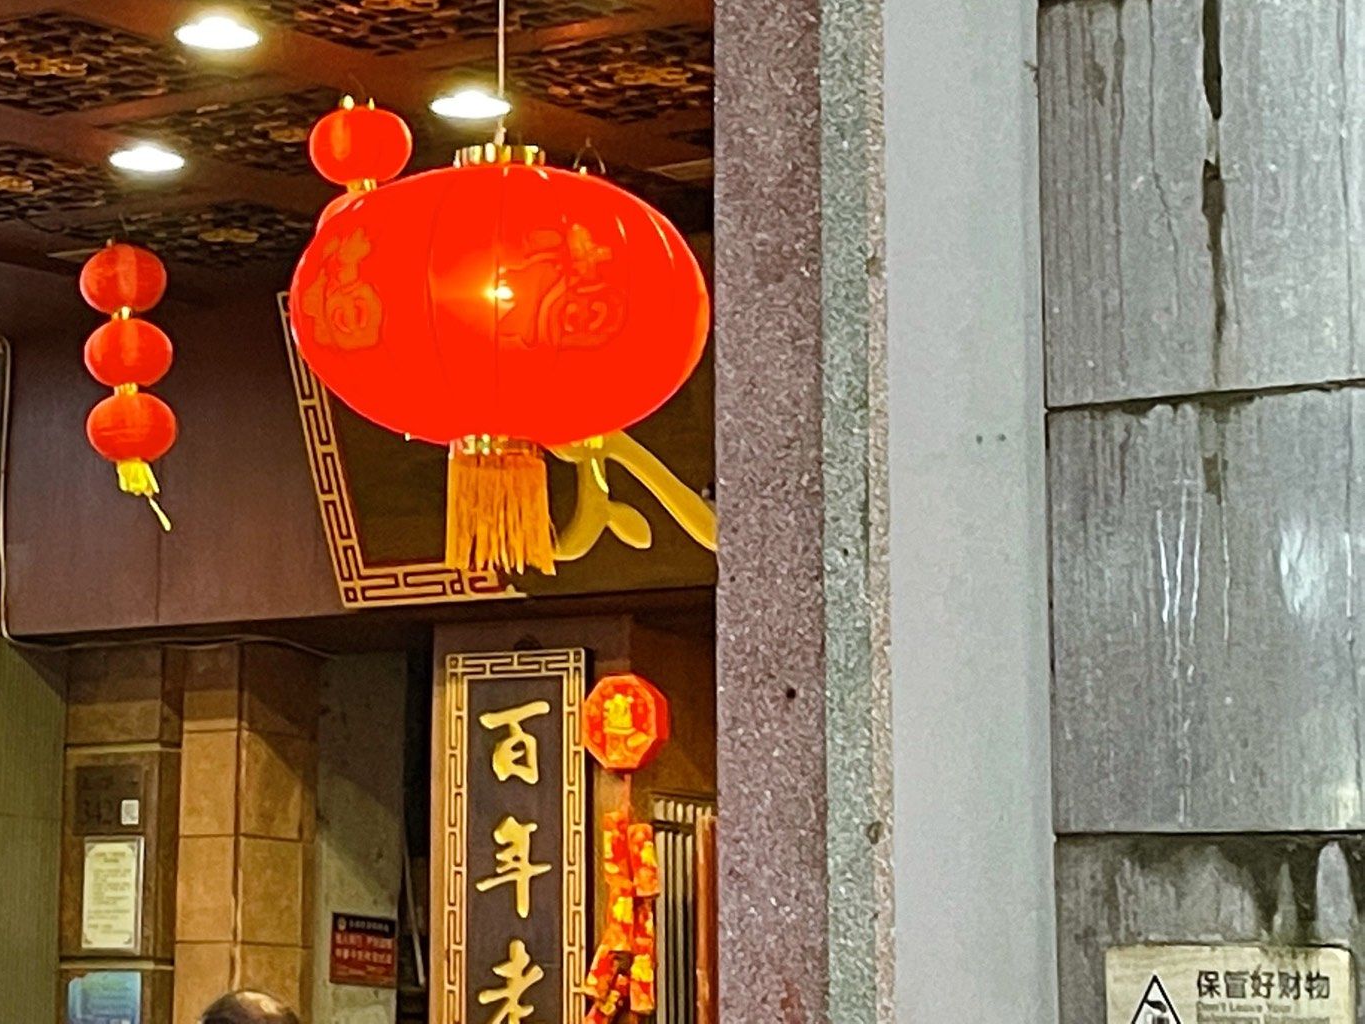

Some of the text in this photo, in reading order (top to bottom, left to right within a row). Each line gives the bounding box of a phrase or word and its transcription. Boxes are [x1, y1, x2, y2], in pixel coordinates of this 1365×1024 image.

[1196, 969, 1330, 1000] 保管好财物
